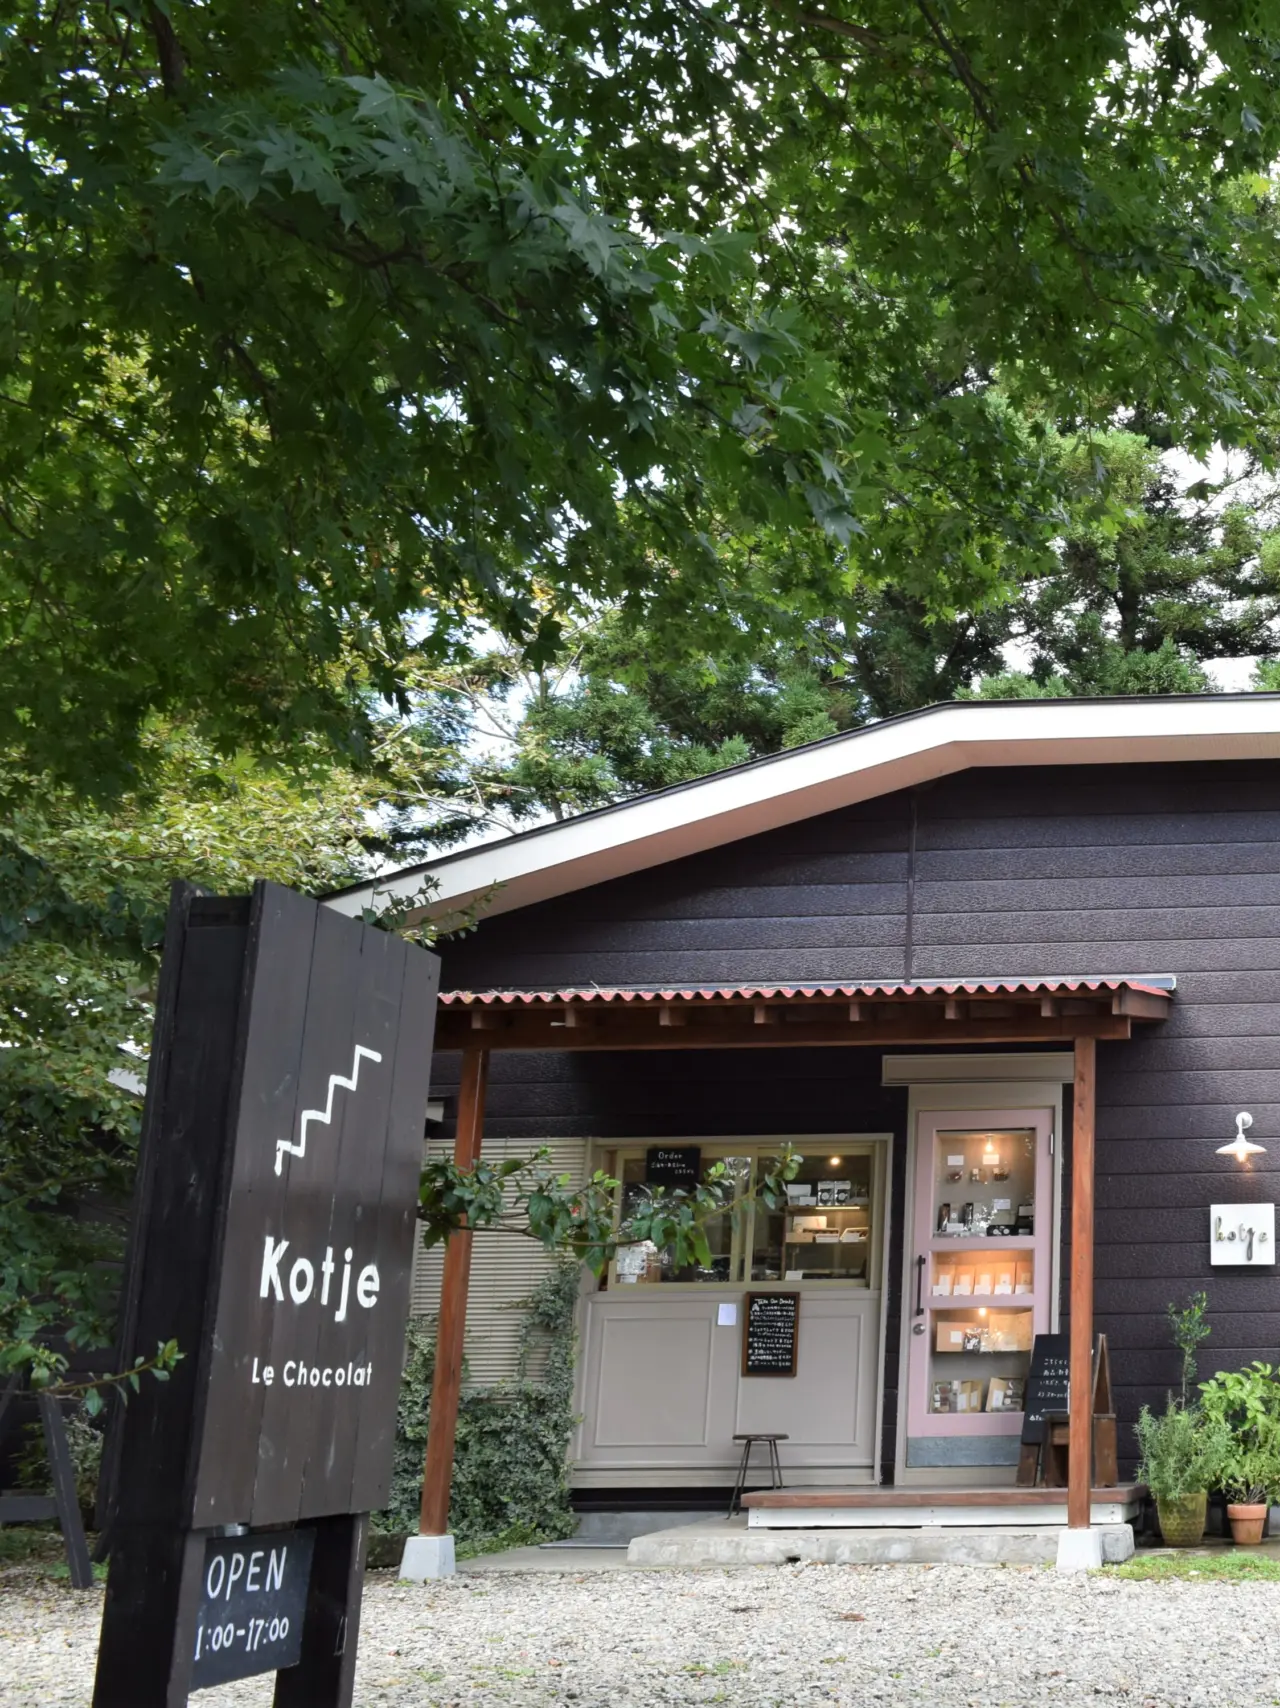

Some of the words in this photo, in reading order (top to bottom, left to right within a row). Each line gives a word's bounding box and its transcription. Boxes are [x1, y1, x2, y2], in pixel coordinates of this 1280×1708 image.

[658, 1151, 683, 1160] Order
[260, 1236, 380, 1322] Kotje
[252, 1357, 275, 1386] Le
[283, 1360, 372, 1387] Chocolat
[207, 1546, 288, 1601] OPEN
